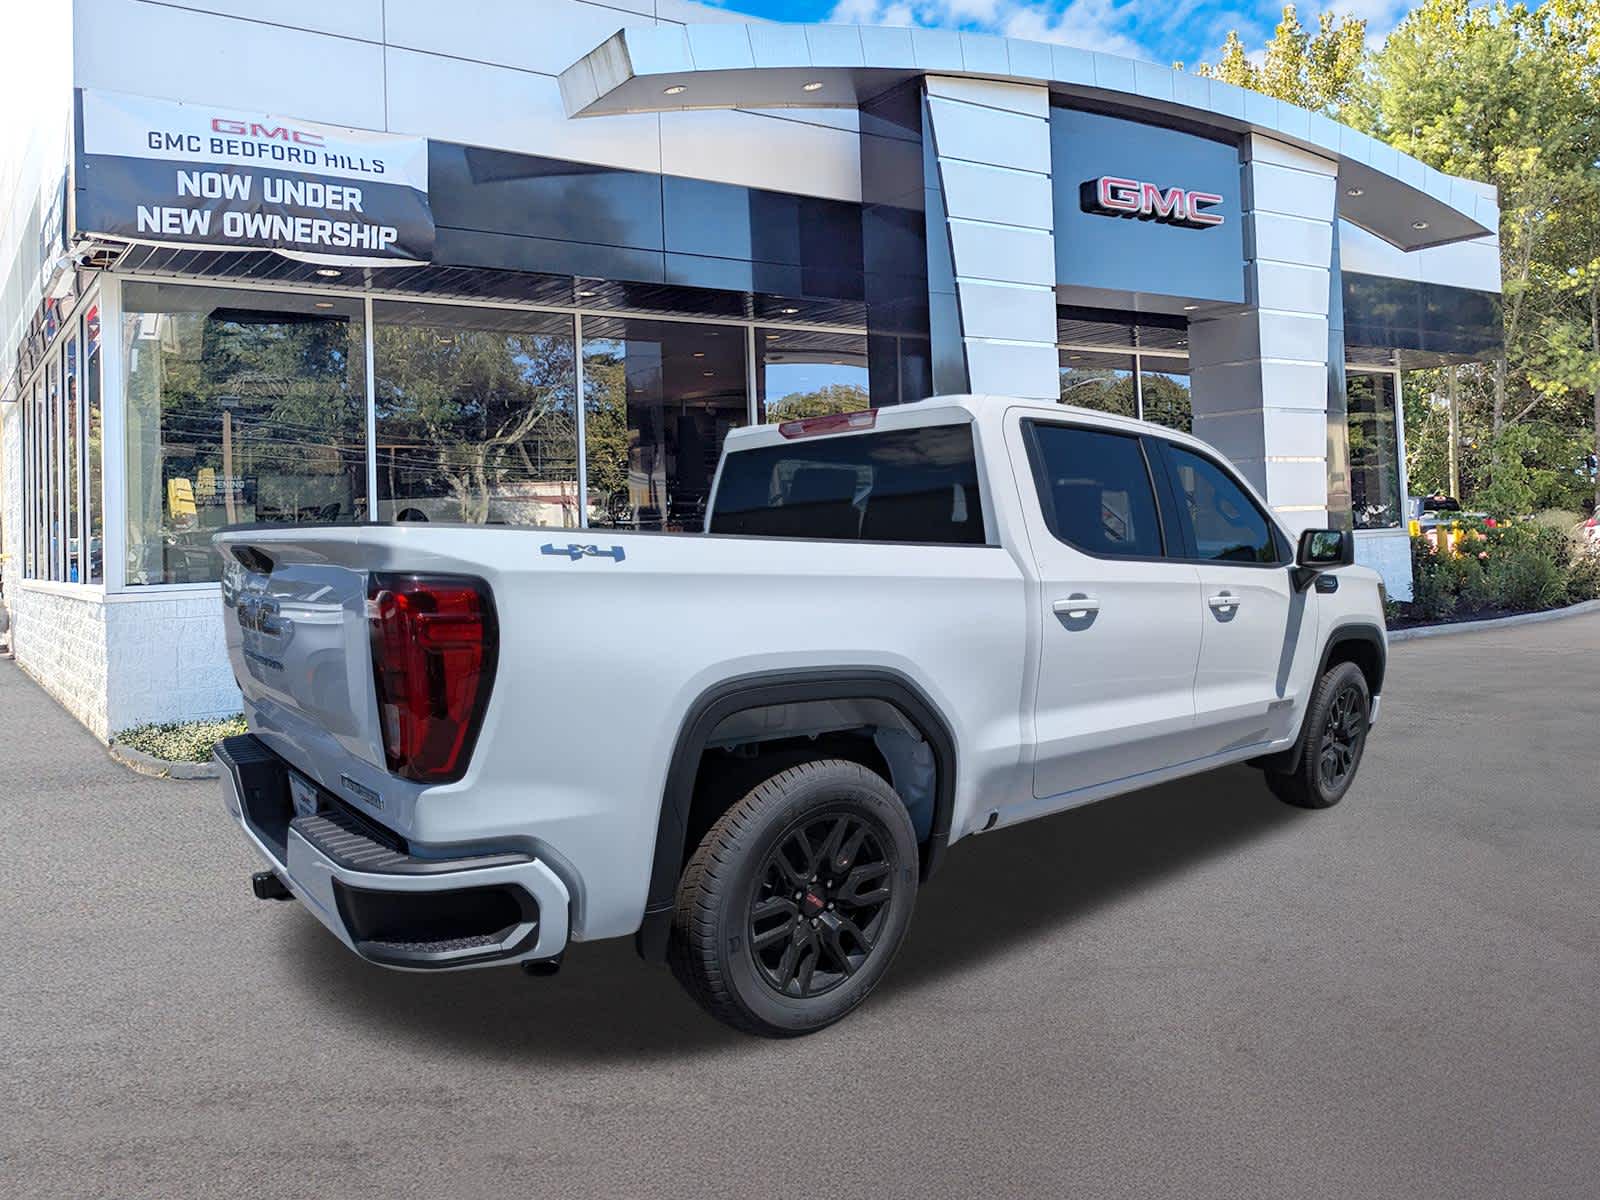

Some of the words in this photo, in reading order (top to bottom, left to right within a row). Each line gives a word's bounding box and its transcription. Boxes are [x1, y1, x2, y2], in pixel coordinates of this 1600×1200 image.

[148, 131, 201, 153] GMC
[210, 138, 316, 166] BEDFORD
[324, 154, 385, 174] HILLS
[211, 117, 325, 147] GMC
[176, 169, 252, 201] NOW
[263, 177, 363, 213] UNDER
[1097, 175, 1225, 225] GMC
[136, 205, 212, 236] NEW
[223, 211, 398, 250] OWNERSHIP
